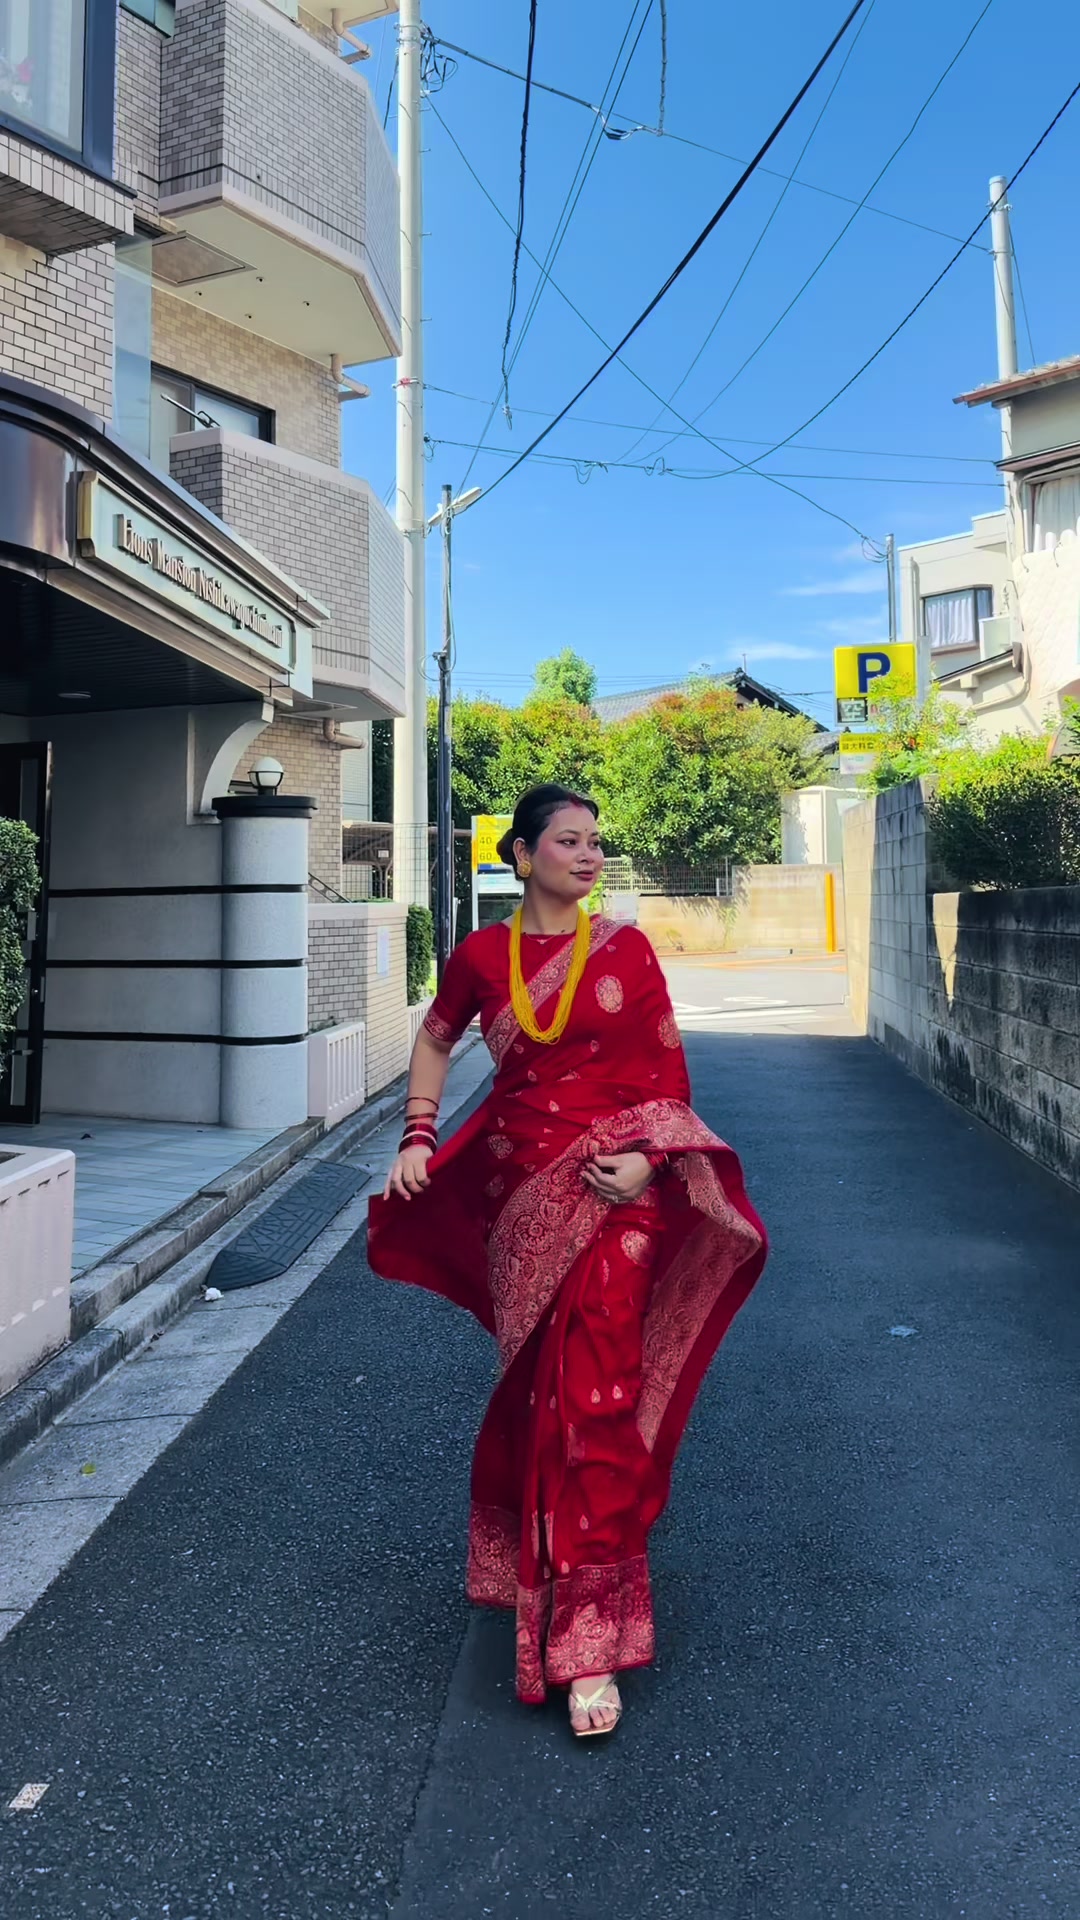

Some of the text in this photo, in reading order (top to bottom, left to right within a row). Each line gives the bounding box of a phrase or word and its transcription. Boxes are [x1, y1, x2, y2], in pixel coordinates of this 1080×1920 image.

[121, 515, 153, 565] Lions
[156, 538, 197, 592] Mansion
[857, 652, 891, 694] P
[479, 836, 492, 845] 40
[479, 852, 492, 861] 60
